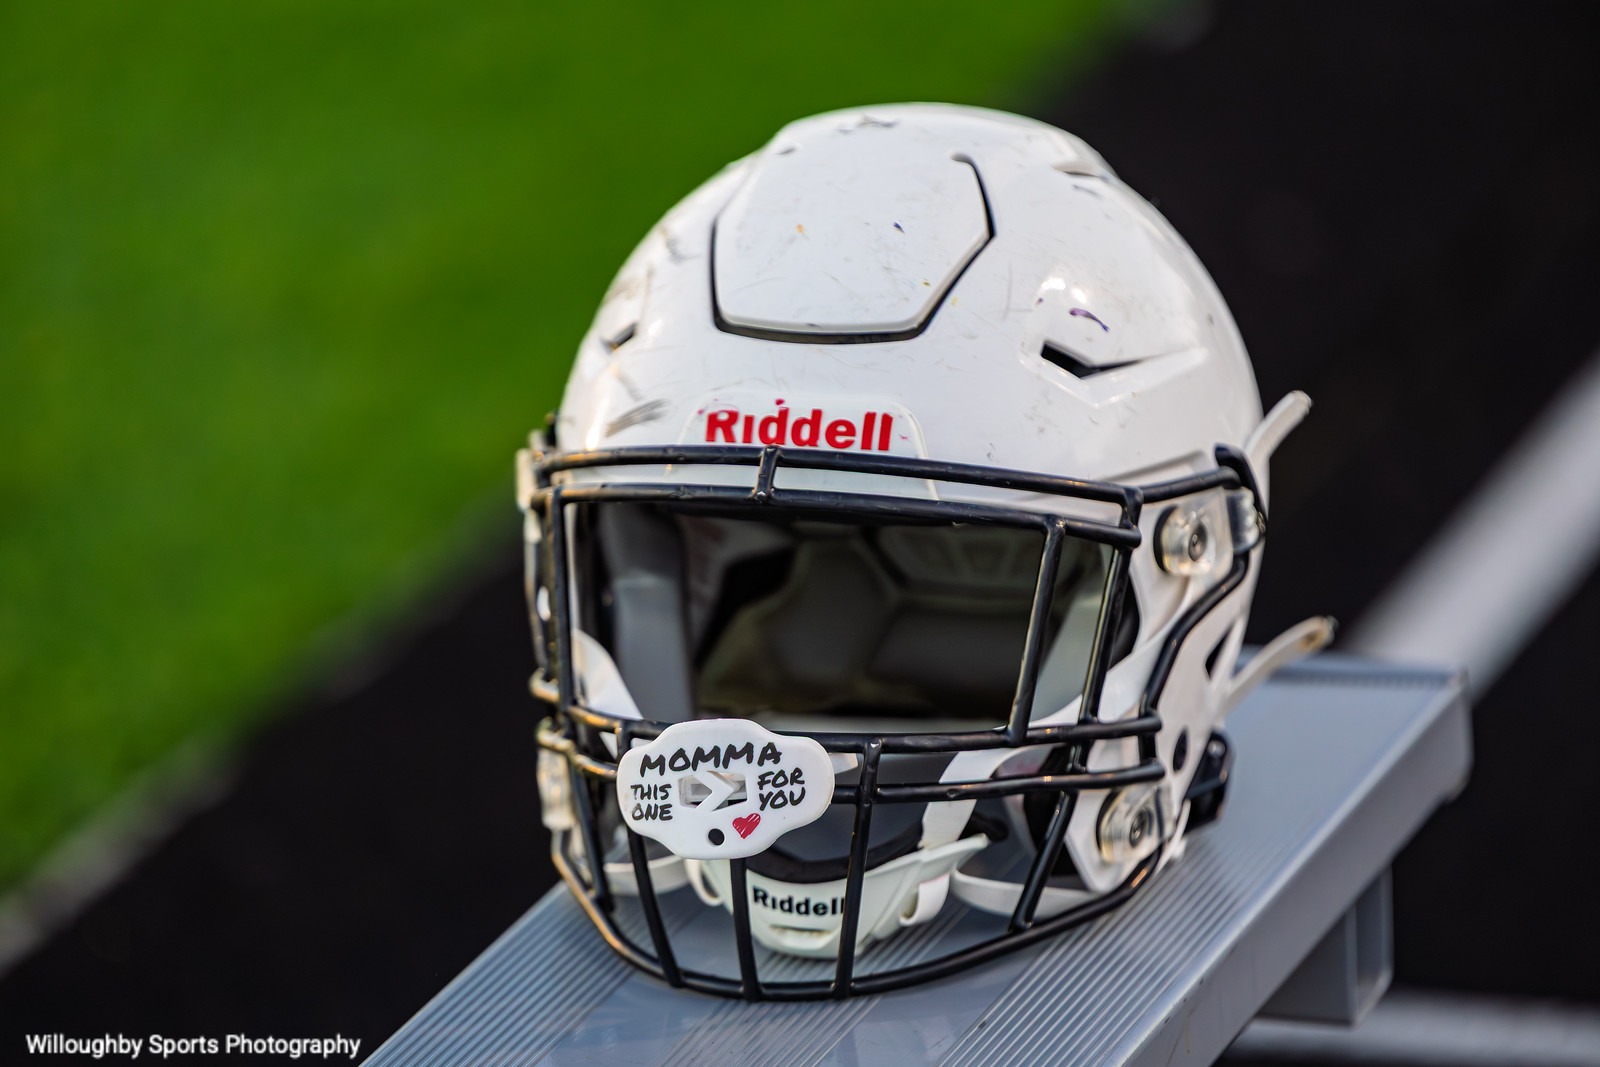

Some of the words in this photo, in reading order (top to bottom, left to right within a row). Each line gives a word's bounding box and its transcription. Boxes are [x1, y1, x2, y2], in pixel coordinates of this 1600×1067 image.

[706, 406, 893, 451] Riddell
[640, 742, 782, 777] MOMMA
[757, 767, 806, 790] FOR
[630, 783, 672, 800] THIS
[758, 787, 806, 811] YOU
[631, 803, 673, 821] ONE
[752, 885, 845, 916] Riddell
